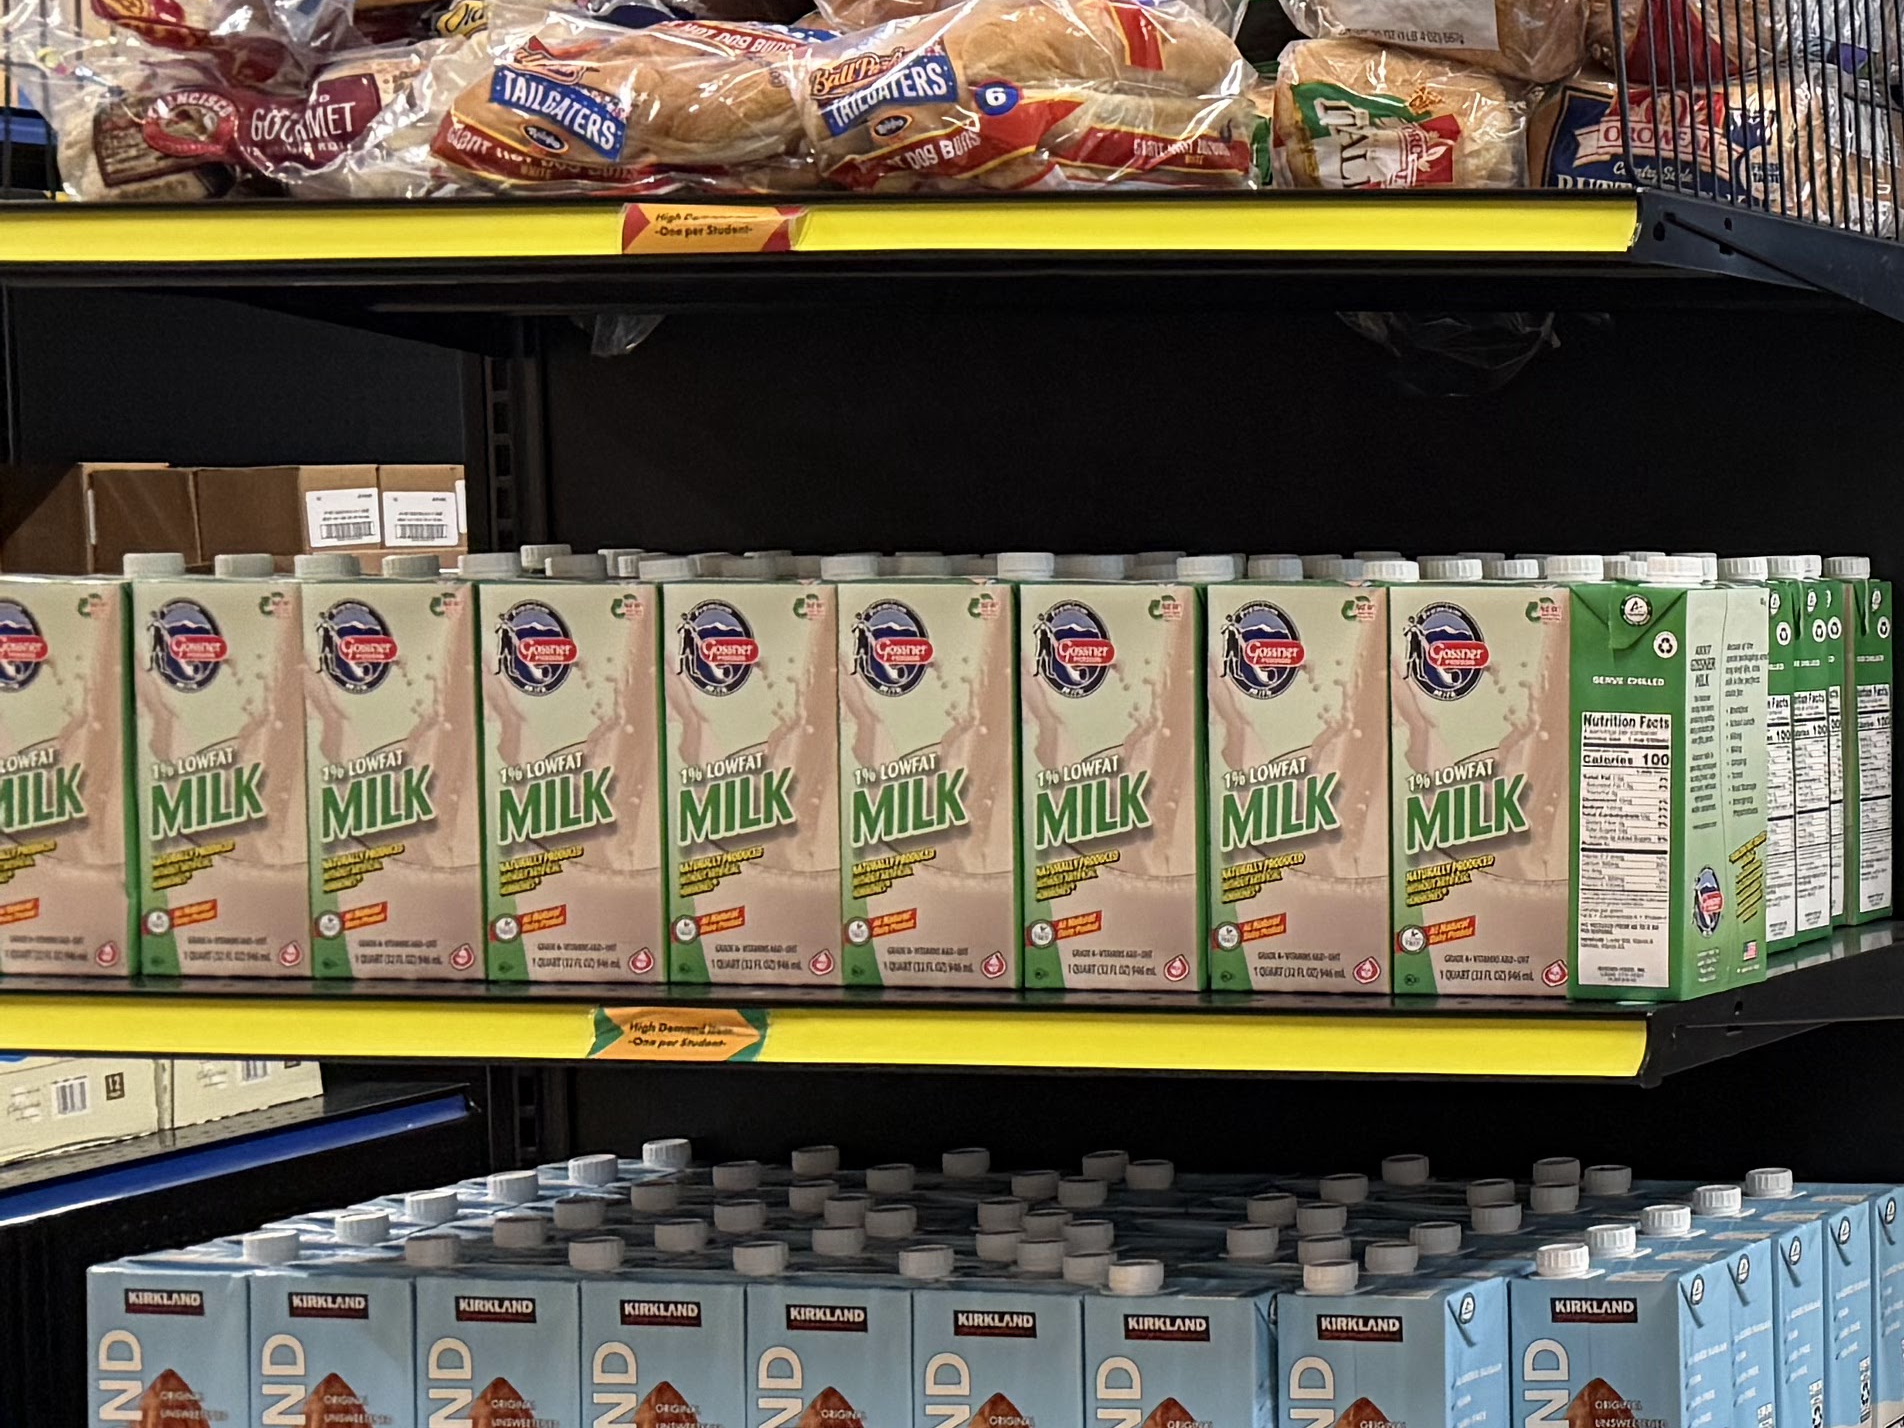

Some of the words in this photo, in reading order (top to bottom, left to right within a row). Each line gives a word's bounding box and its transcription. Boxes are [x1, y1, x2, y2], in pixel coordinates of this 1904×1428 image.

[985, 87, 1007, 106] 6
[504, 72, 617, 151] TAILGATERS
[1058, 641, 1111, 661] Gossner
[1583, 714, 1636, 731] Nutrition
[1640, 716, 1669, 730] Facts
[1582, 754, 1634, 766] Calories
[1642, 754, 1669, 766] 100
[1036, 768, 1060, 789] 1%
[1063, 756, 1119, 783] LOWFAT
[1034, 771, 1151, 849] MILK
[1128, 1317, 1207, 1333] KIRKLAND
